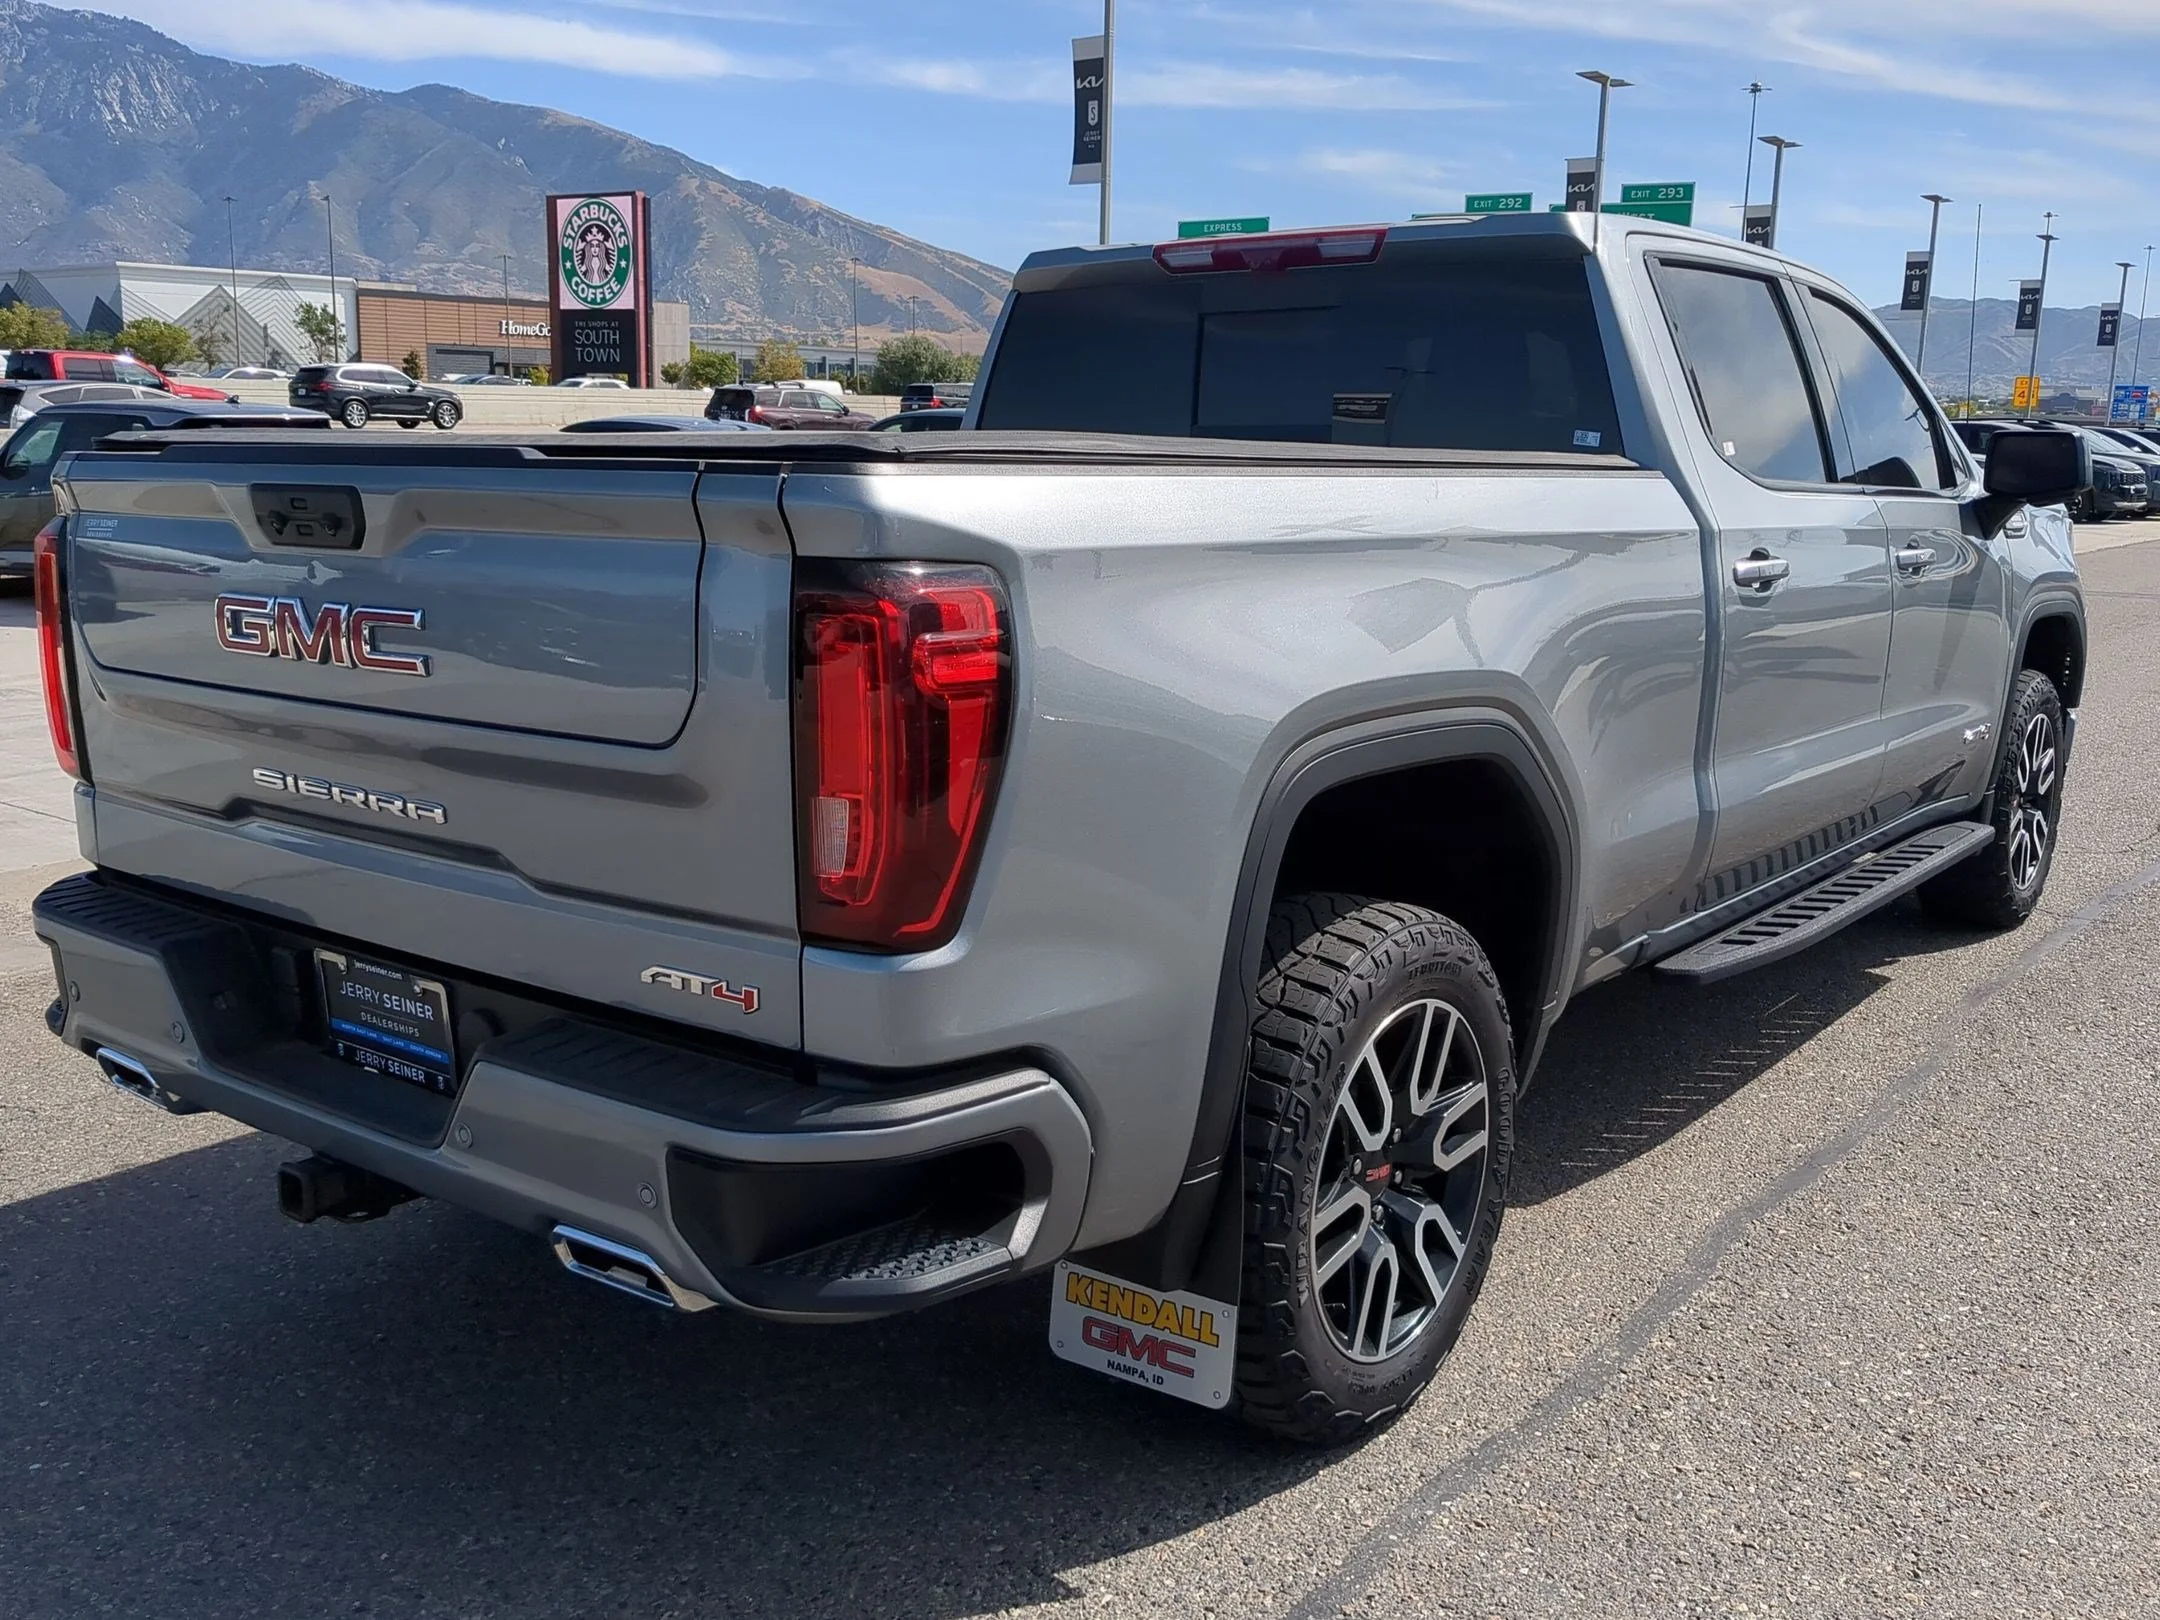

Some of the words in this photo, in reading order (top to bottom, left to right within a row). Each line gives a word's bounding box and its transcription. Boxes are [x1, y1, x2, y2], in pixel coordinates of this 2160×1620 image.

[1474, 200, 1492, 208] EXIT
[1498, 198, 1522, 209] 292
[1630, 189, 1651, 198] EXIT
[1658, 187, 1684, 199] 293
[563, 204, 629, 250] STARBUCKS
[1203, 222, 1242, 233] EXPRESS
[571, 276, 621, 303] COFFEE
[575, 329, 620, 344] SOUTH
[575, 347, 620, 362] TOWN
[215, 592, 433, 678] GMC
[252, 766, 448, 825] SIERRA
[353, 959, 403, 980] jerryseiner.com
[339, 980, 380, 1005] JERRY
[383, 993, 434, 1021] SEINER
[640, 965, 760, 1014] AT4
[360, 1011, 420, 1037] DEALERSHIPS
[355, 1049, 386, 1069] JERRY
[388, 1060, 426, 1084] SEINER
[1065, 1271, 1219, 1348] KENDALL
[1082, 1315, 1196, 1379] GMC
[1106, 1359, 1149, 1384] NAMPA,
[1152, 1374, 1164, 1386] ID
